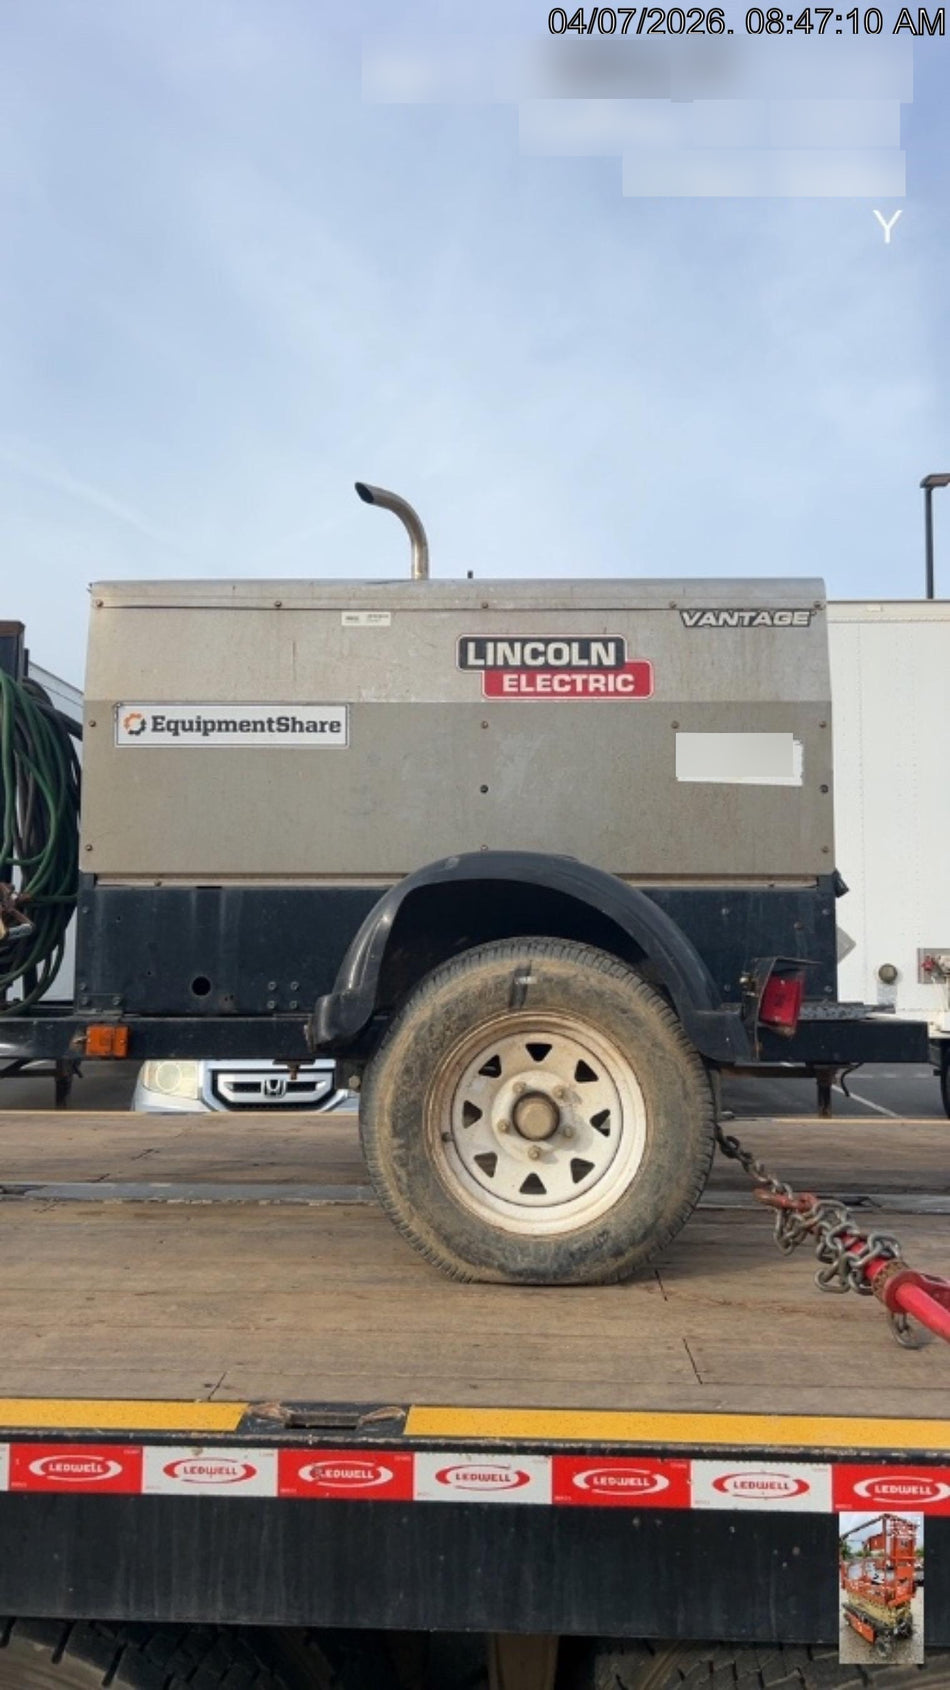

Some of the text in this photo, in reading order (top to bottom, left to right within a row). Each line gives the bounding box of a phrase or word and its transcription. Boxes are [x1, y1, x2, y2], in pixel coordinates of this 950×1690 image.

[680, 610, 811, 627] VANTAGE
[466, 641, 617, 666] LINCOLN
[502, 673, 636, 693] ELECTRIC
[151, 715, 341, 737] EquipmentShare
[49, 1462, 103, 1474] LEDWELL
[183, 1464, 239, 1478] LEDWELL
[455, 1471, 511, 1484] LEDWELL
[593, 1475, 651, 1487] LEDWELL
[733, 1479, 790, 1491] LEDWELL
[874, 1484, 932, 1496] LEDWELL
